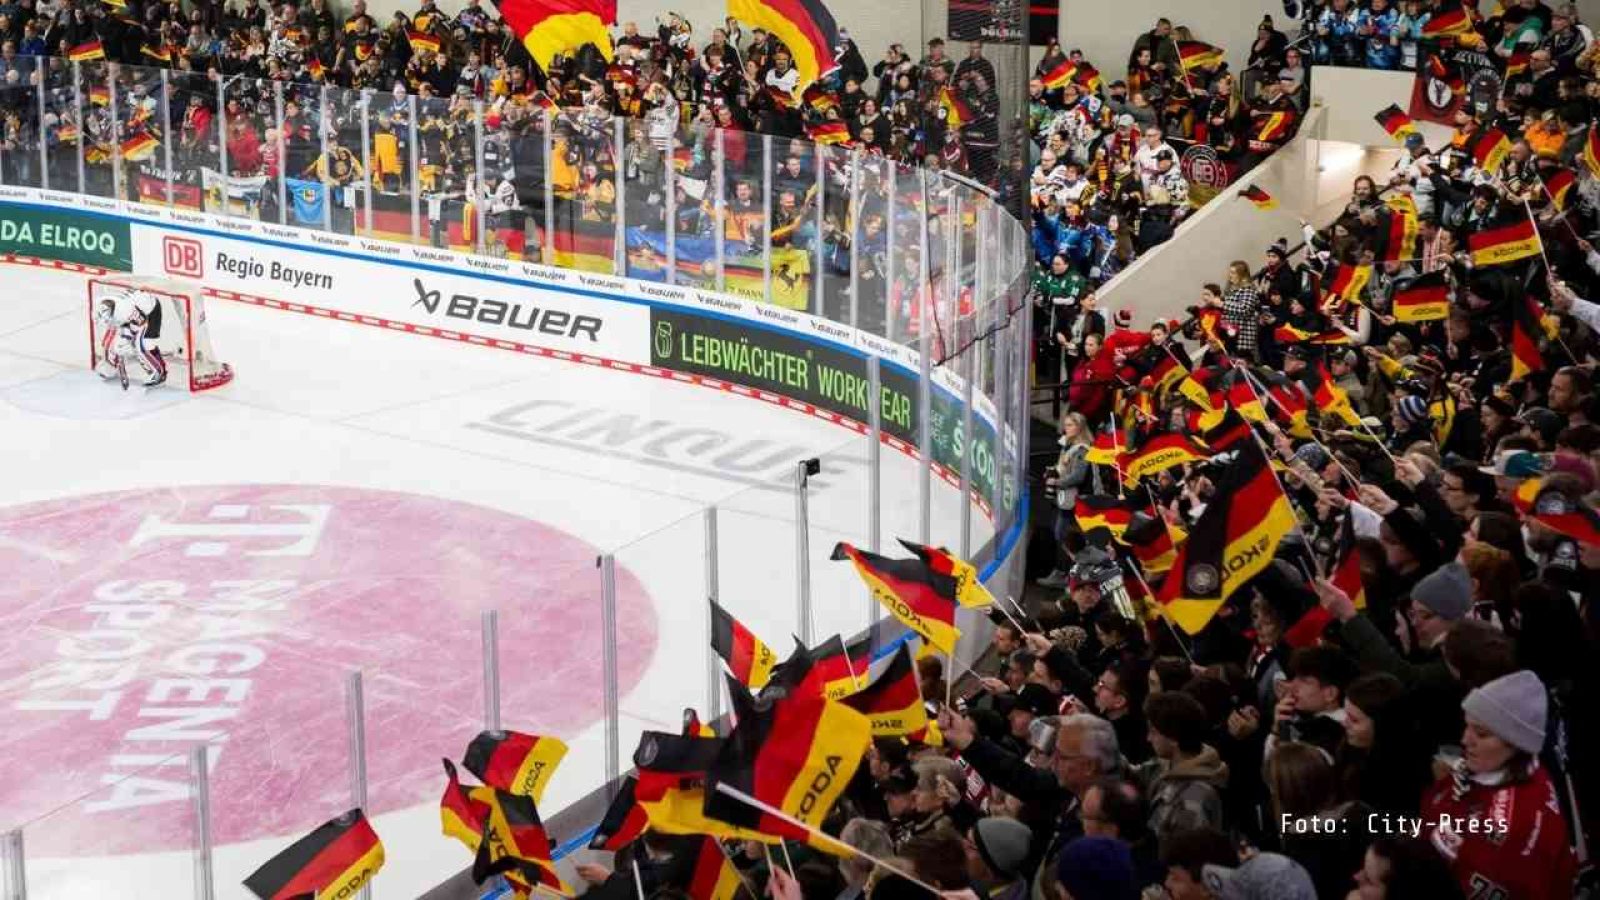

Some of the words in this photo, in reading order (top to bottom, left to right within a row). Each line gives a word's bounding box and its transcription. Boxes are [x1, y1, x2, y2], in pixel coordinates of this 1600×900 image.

[1, 219, 34, 245] DA
[40, 223, 116, 255] ELROQ
[168, 243, 199, 272] DB
[216, 252, 265, 279] Regio
[270, 260, 333, 289] Bayern
[681, 331, 808, 391] LEIBWÄCHTER
[816, 364, 911, 430] WORKEAR
[14, 579, 187, 721] SPORT
[85, 578, 299, 813] MAGENTA
